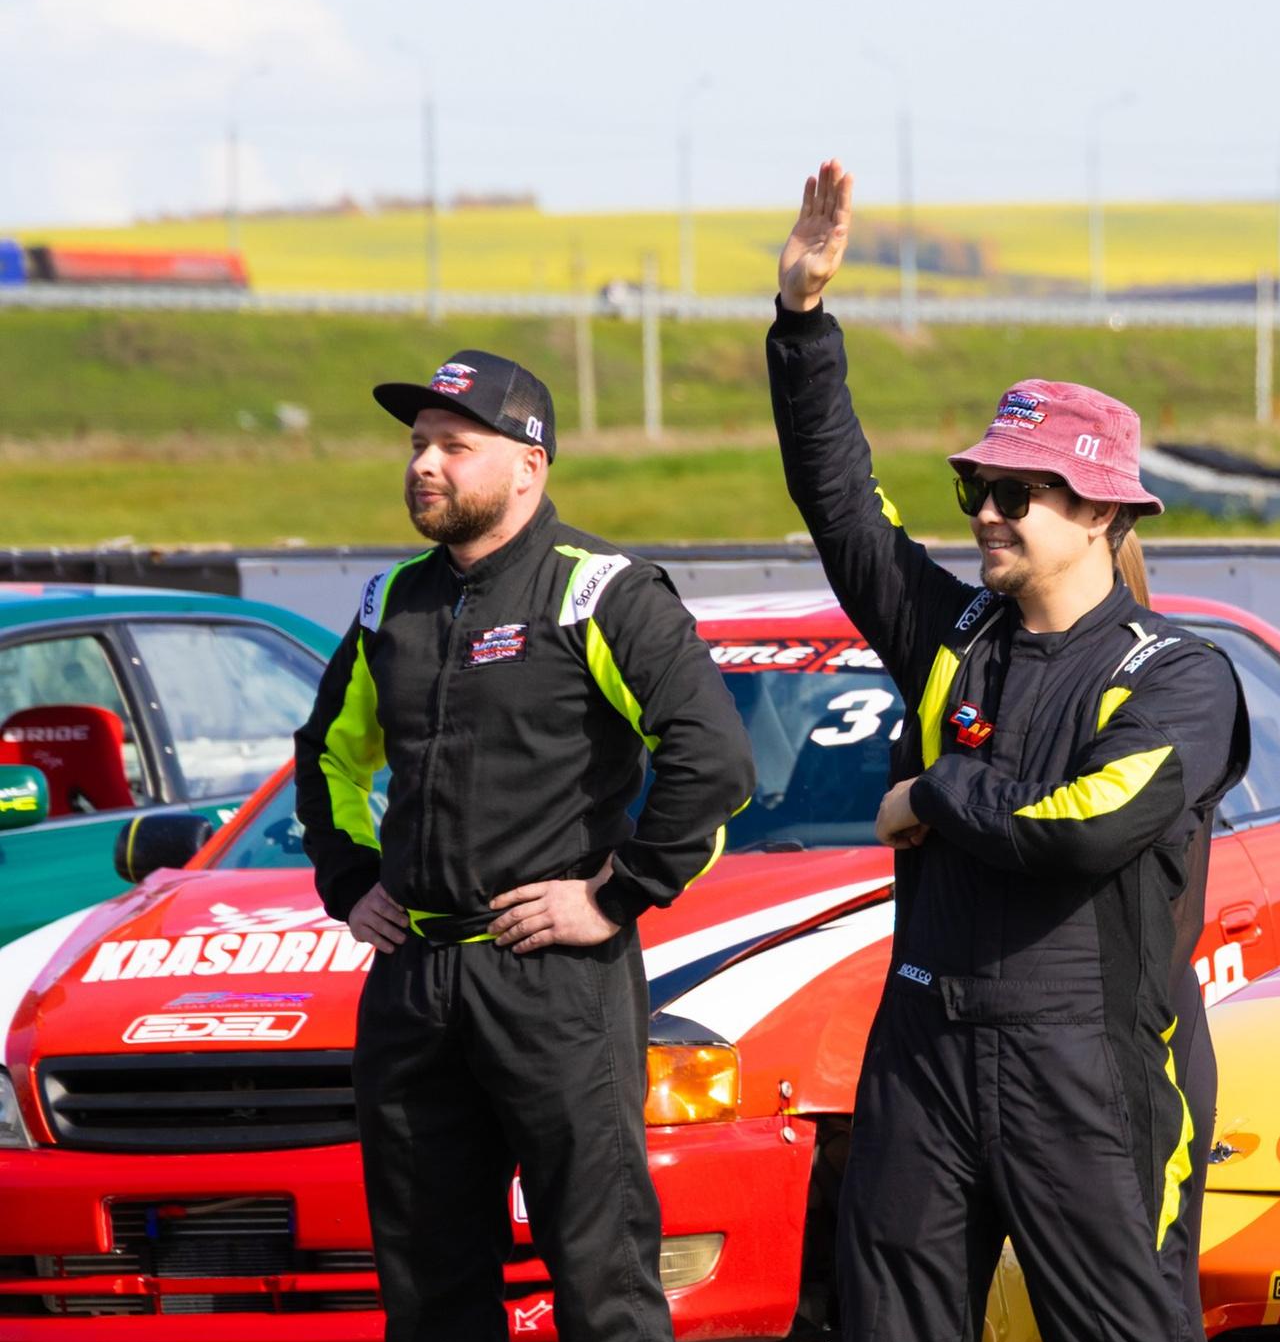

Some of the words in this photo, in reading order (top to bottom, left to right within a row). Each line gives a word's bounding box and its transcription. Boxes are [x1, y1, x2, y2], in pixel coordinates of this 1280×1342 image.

[526, 416, 543, 442] 01
[1075, 434, 1101, 460] 01
[575, 562, 613, 607] sparco
[1123, 636, 1182, 674] sparco
[809, 688, 904, 747] 3
[80, 929, 375, 983] KRASDRIV
[897, 963, 932, 985] sparco
[131, 1016, 291, 1039] EDEL
